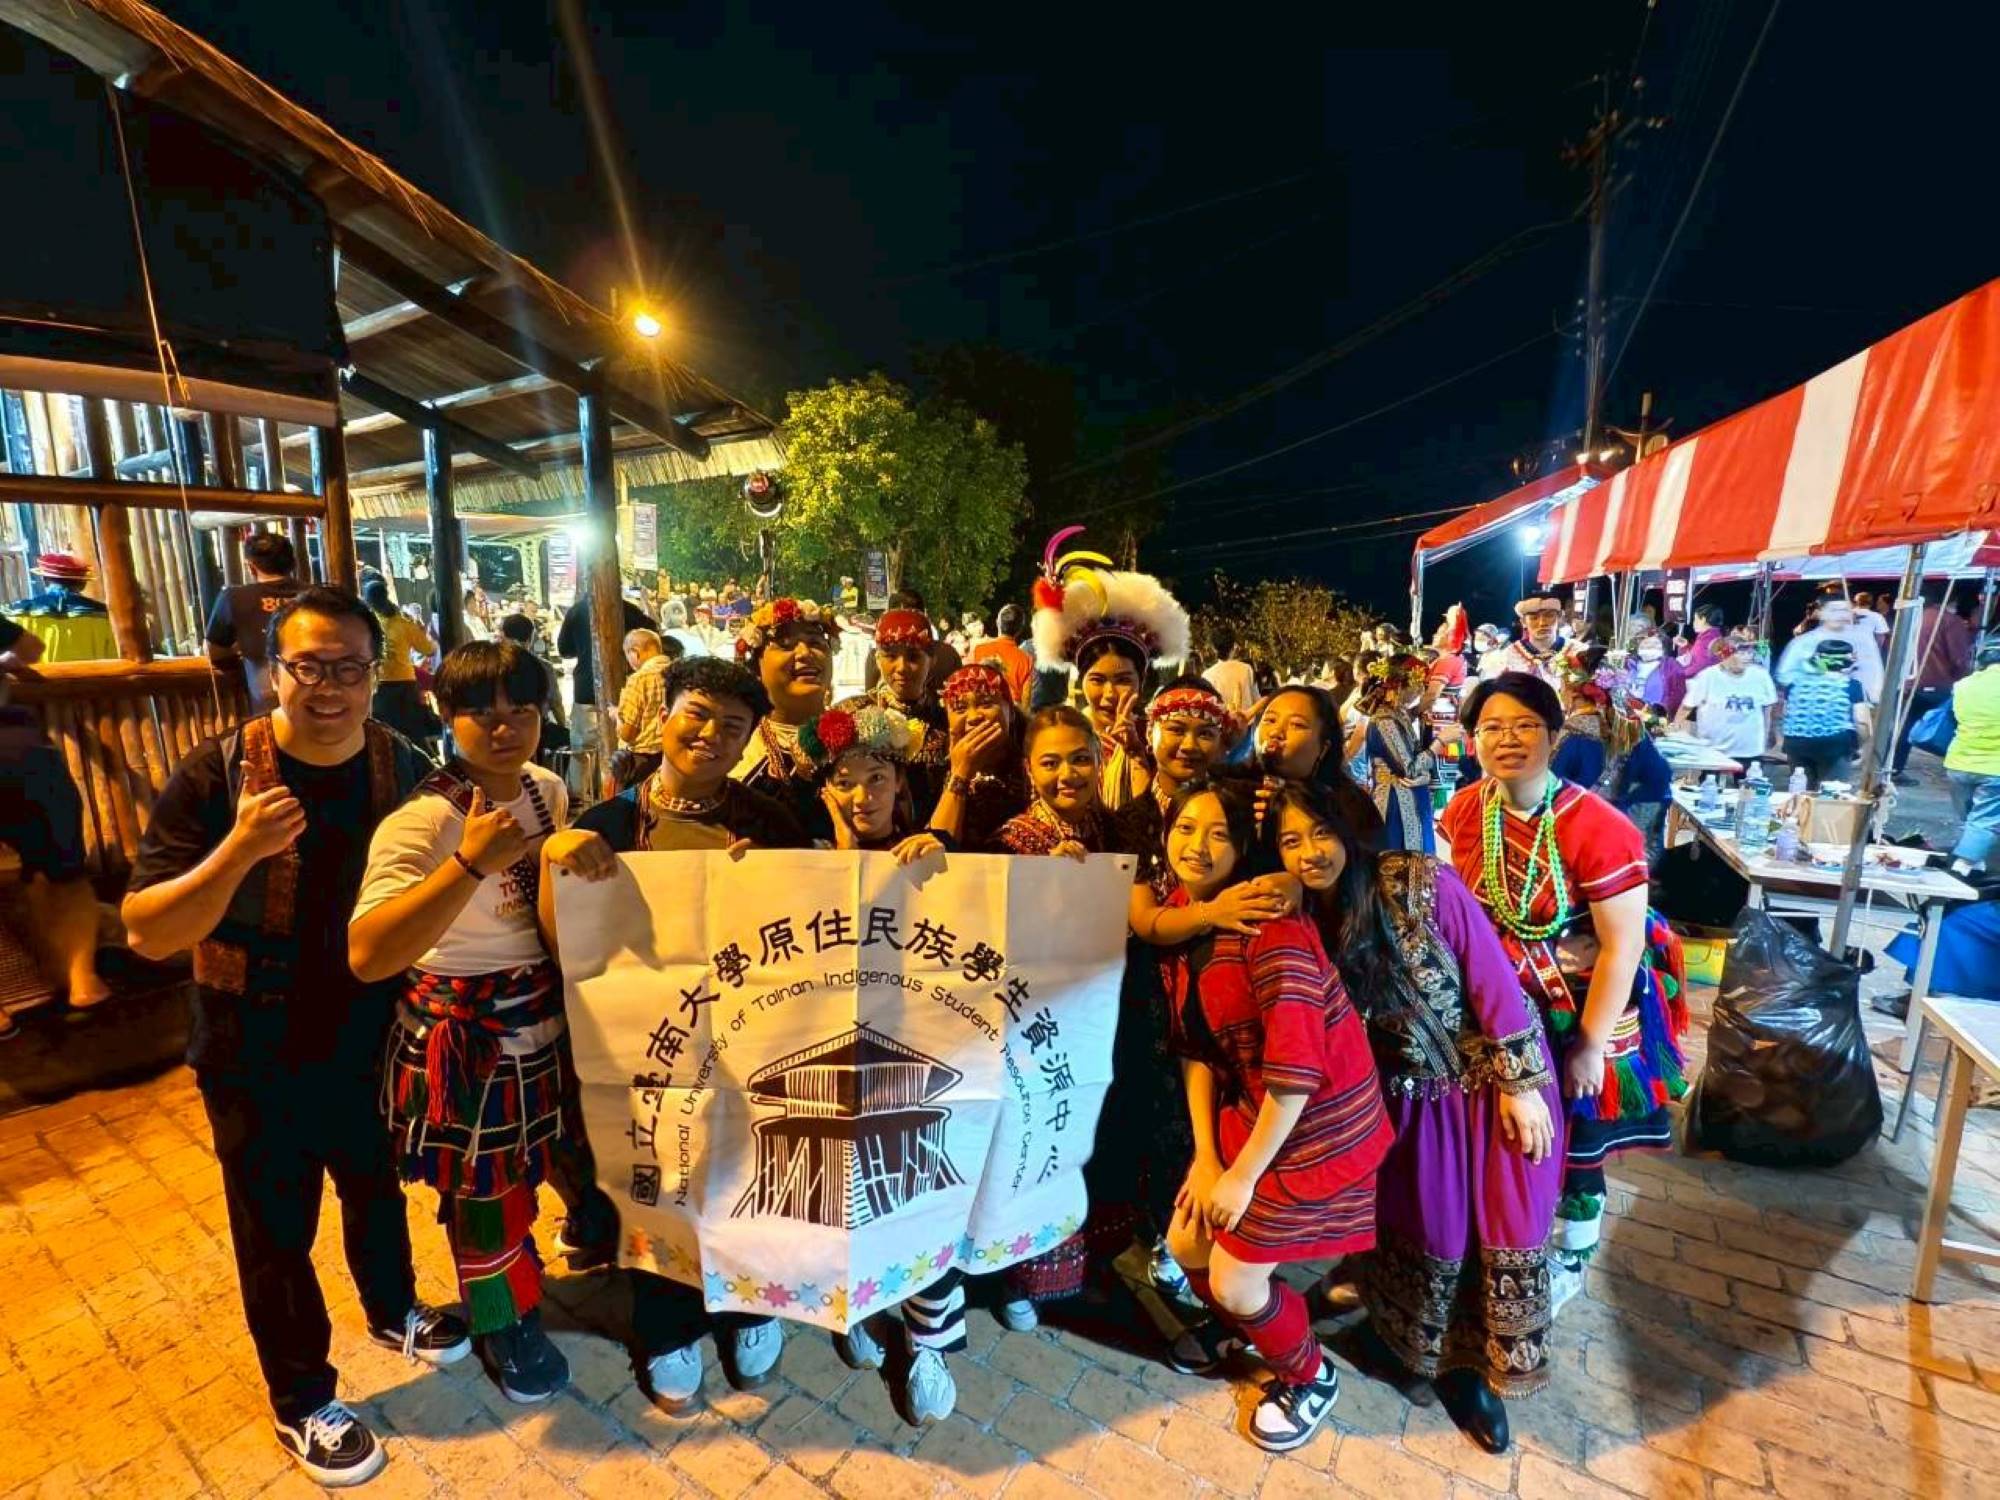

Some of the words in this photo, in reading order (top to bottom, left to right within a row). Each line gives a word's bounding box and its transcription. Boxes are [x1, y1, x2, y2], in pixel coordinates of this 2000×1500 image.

[751, 978, 815, 1013] Tainan
[823, 968, 924, 993] Indigenous
[730, 1009, 747, 1032] of
[930, 985, 1001, 1042] Student
[680, 1032, 729, 1115] University
[1000, 1042, 1032, 1125] Resource
[674, 1124, 692, 1206] National
[1011, 1131, 1032, 1197] Center
